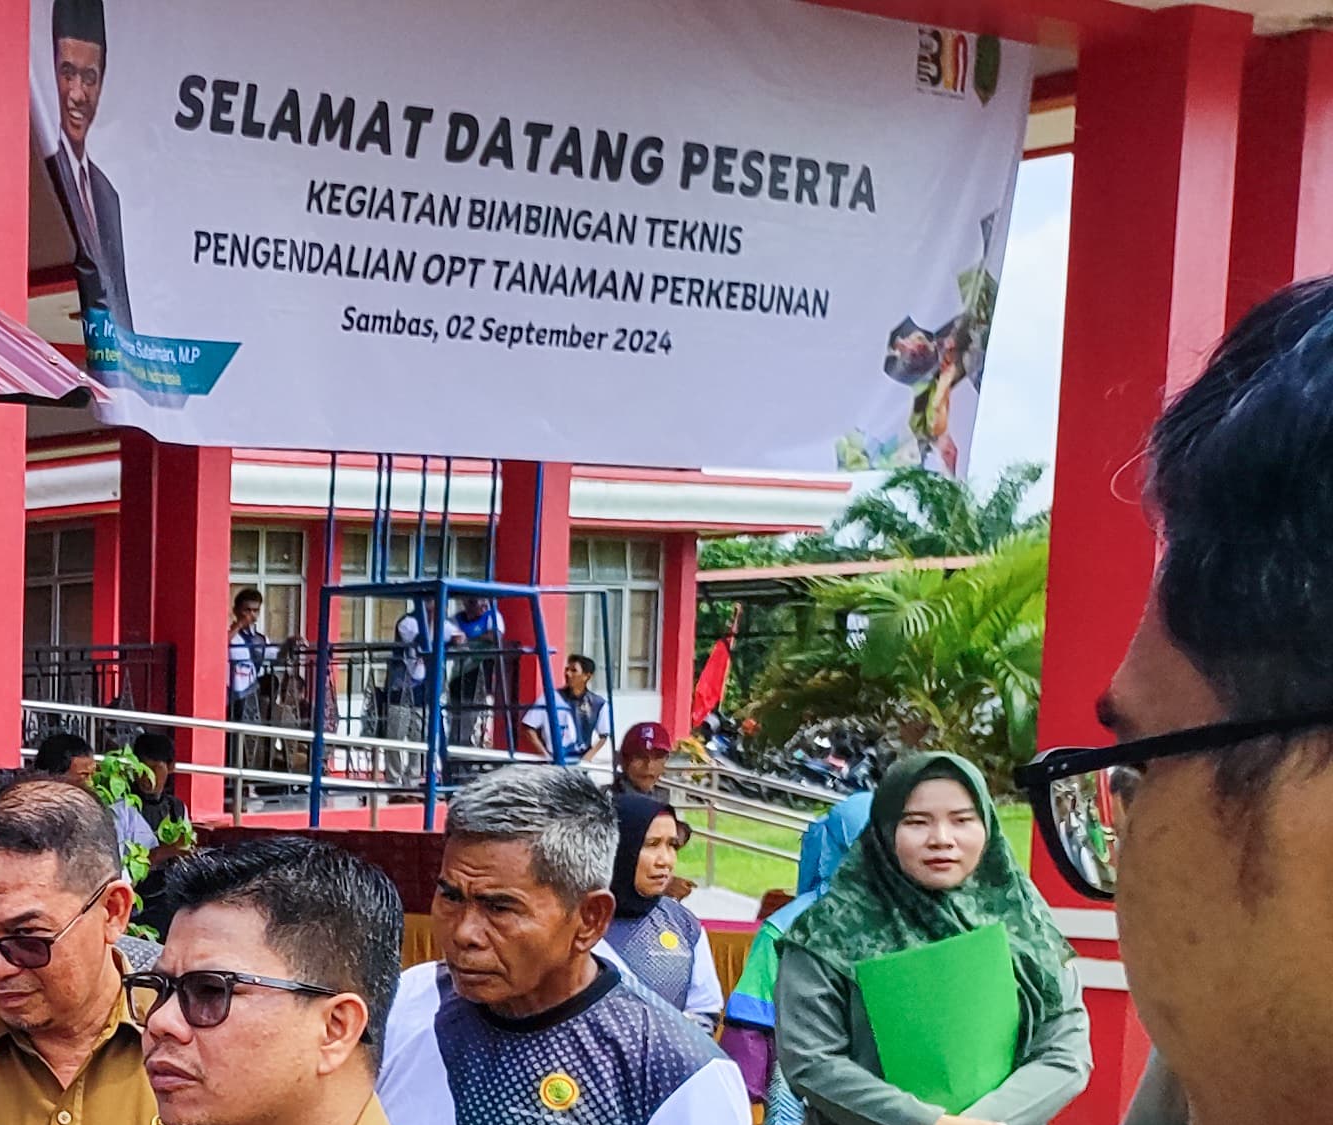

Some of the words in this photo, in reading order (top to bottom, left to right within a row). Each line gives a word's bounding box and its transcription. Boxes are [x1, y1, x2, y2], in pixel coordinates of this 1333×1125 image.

[174, 74, 434, 159] SELAMAT
[445, 111, 665, 186] DATANG
[680, 141, 876, 213] PESERTA
[307, 180, 462, 228] KEGIATAN
[467, 199, 637, 246] BIMBINGAN
[645, 216, 744, 255] TEKNIS
[194, 230, 416, 283] PENGENDALIAN
[422, 253, 486, 289] OPT
[493, 259, 644, 303] TANAMAN
[651, 274, 830, 318] PERKEBUNAN
[341, 305, 439, 343] Sambas,
[446, 314, 475, 340] 02
[479, 317, 609, 350] September
[613, 327, 673, 356] 2024
